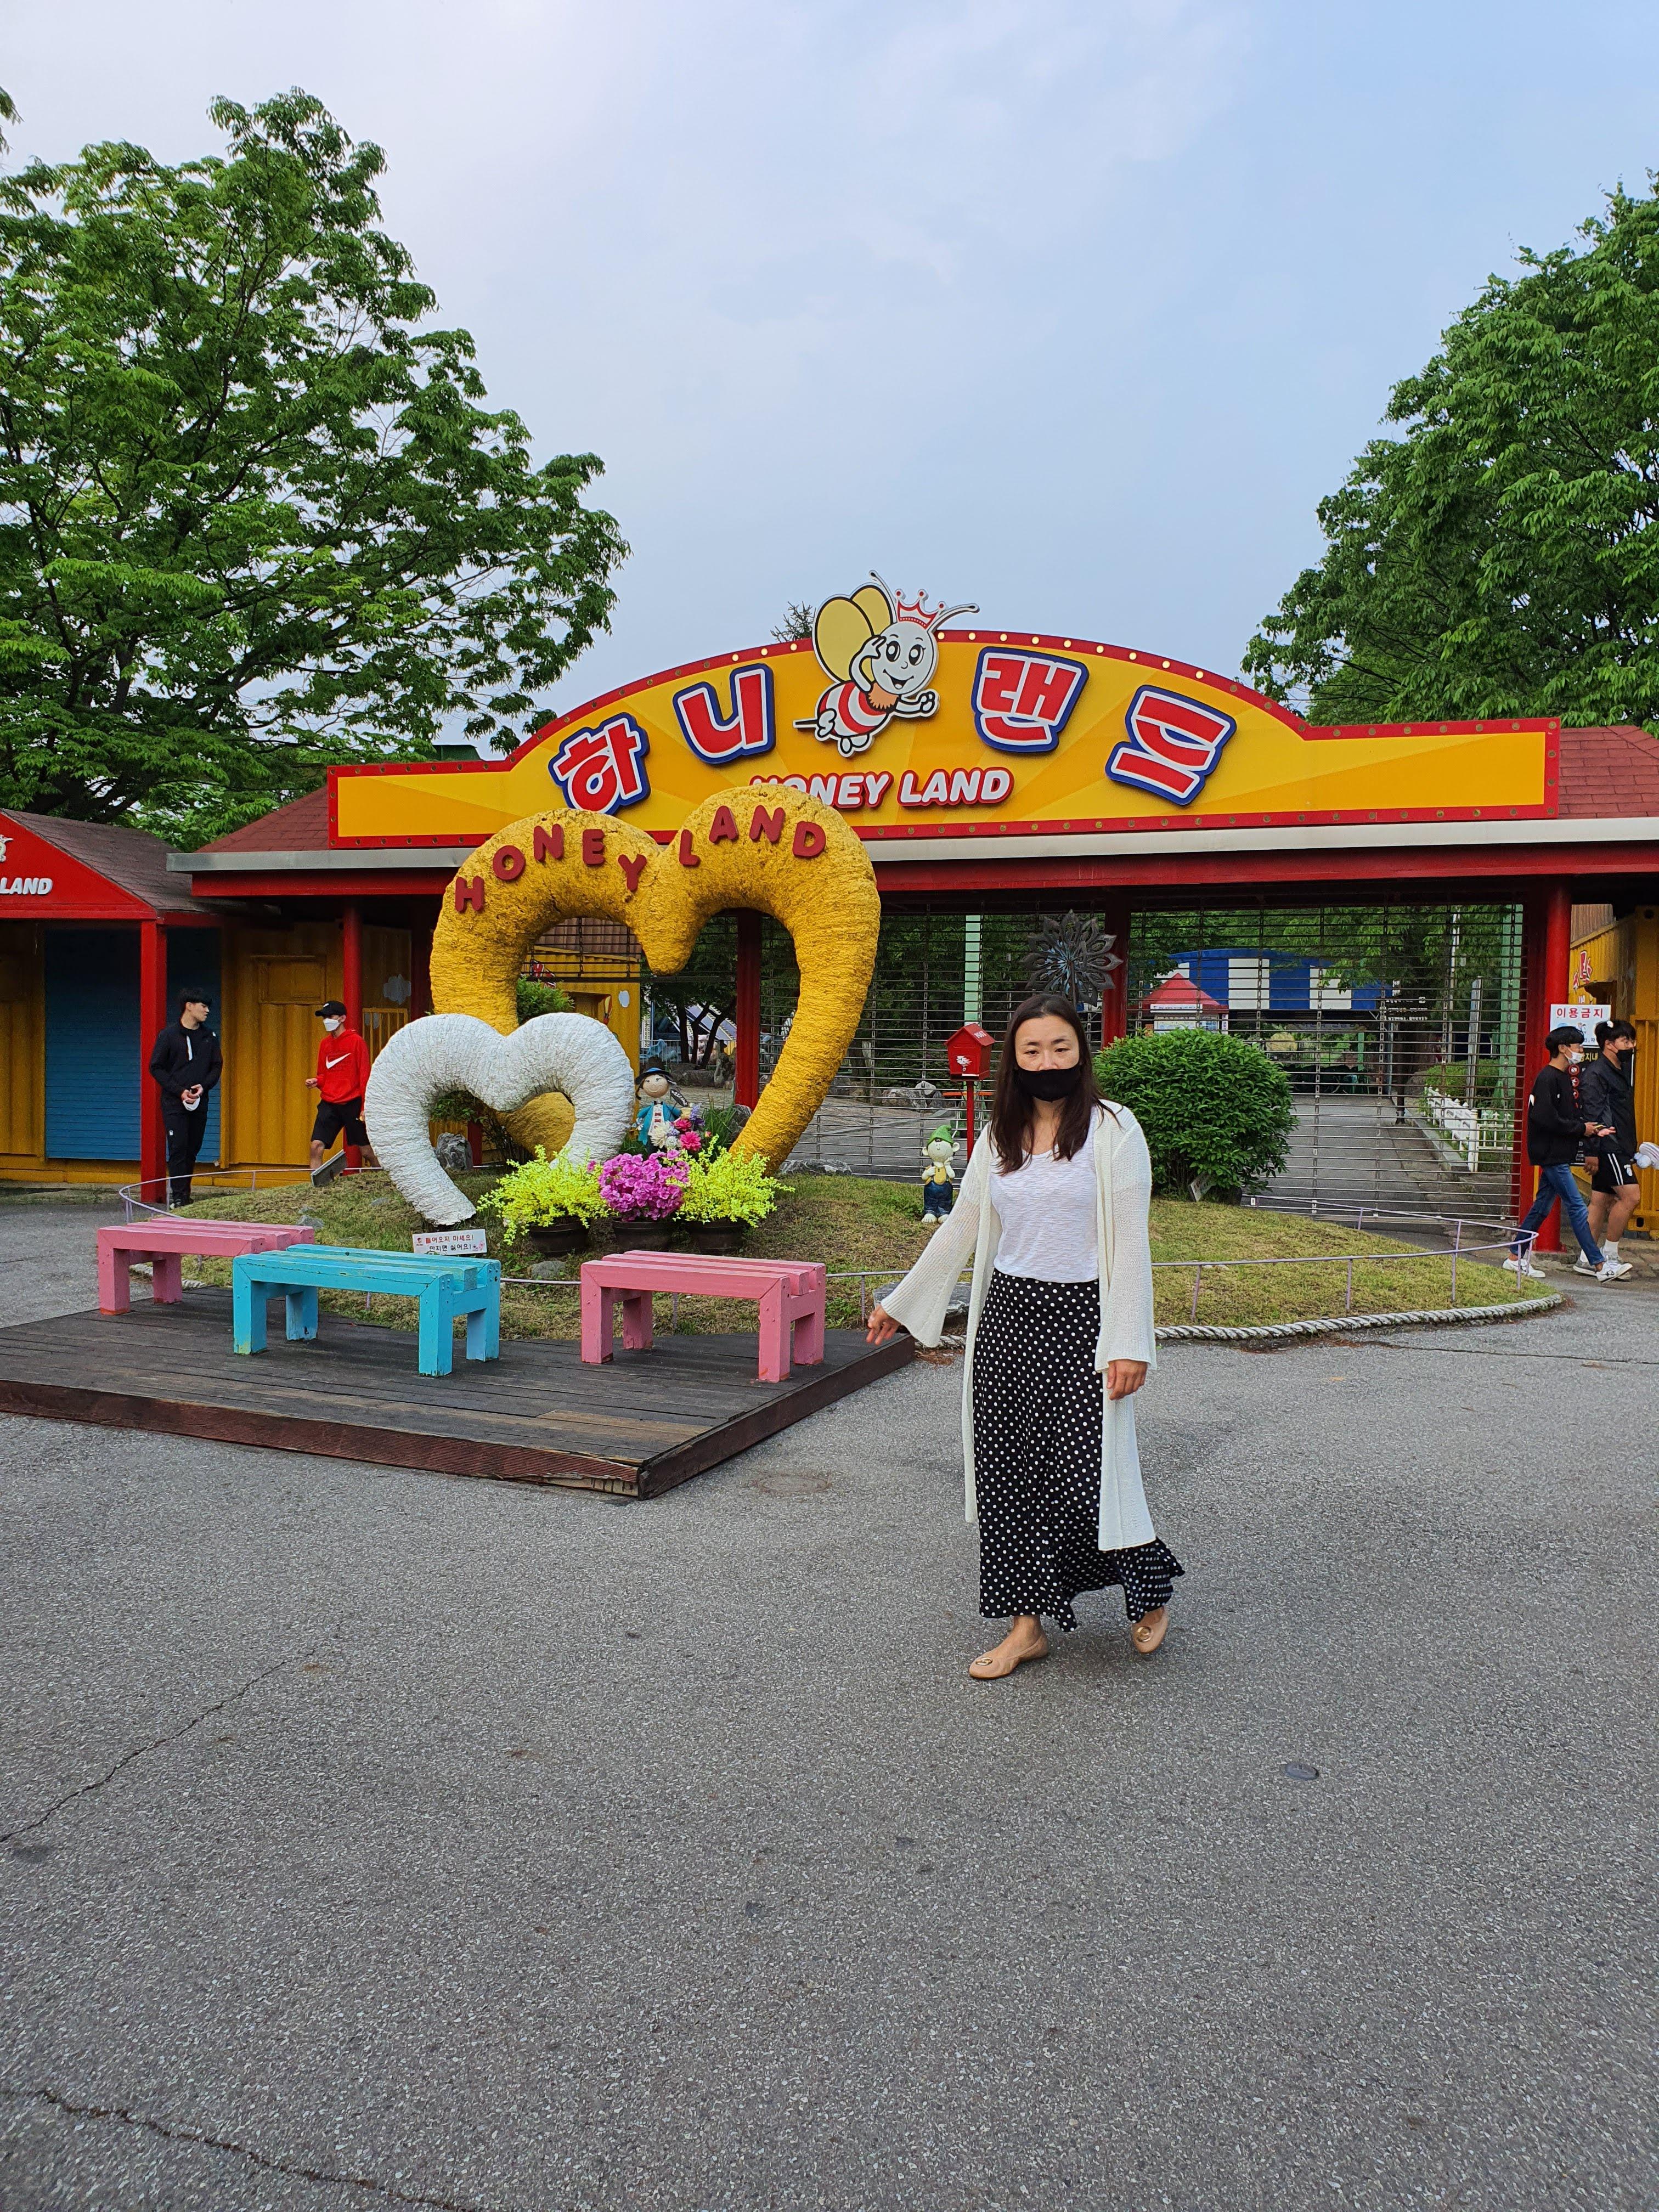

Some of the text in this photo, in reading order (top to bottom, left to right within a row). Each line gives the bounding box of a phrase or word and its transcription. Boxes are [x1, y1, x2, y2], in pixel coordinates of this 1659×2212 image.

[897, 767, 1015, 806] LAND
[455, 805, 827, 913] HONEY LAND
[0, 877, 53, 895] LAND
[1556, 1007, 1604, 1019] 이용금지
